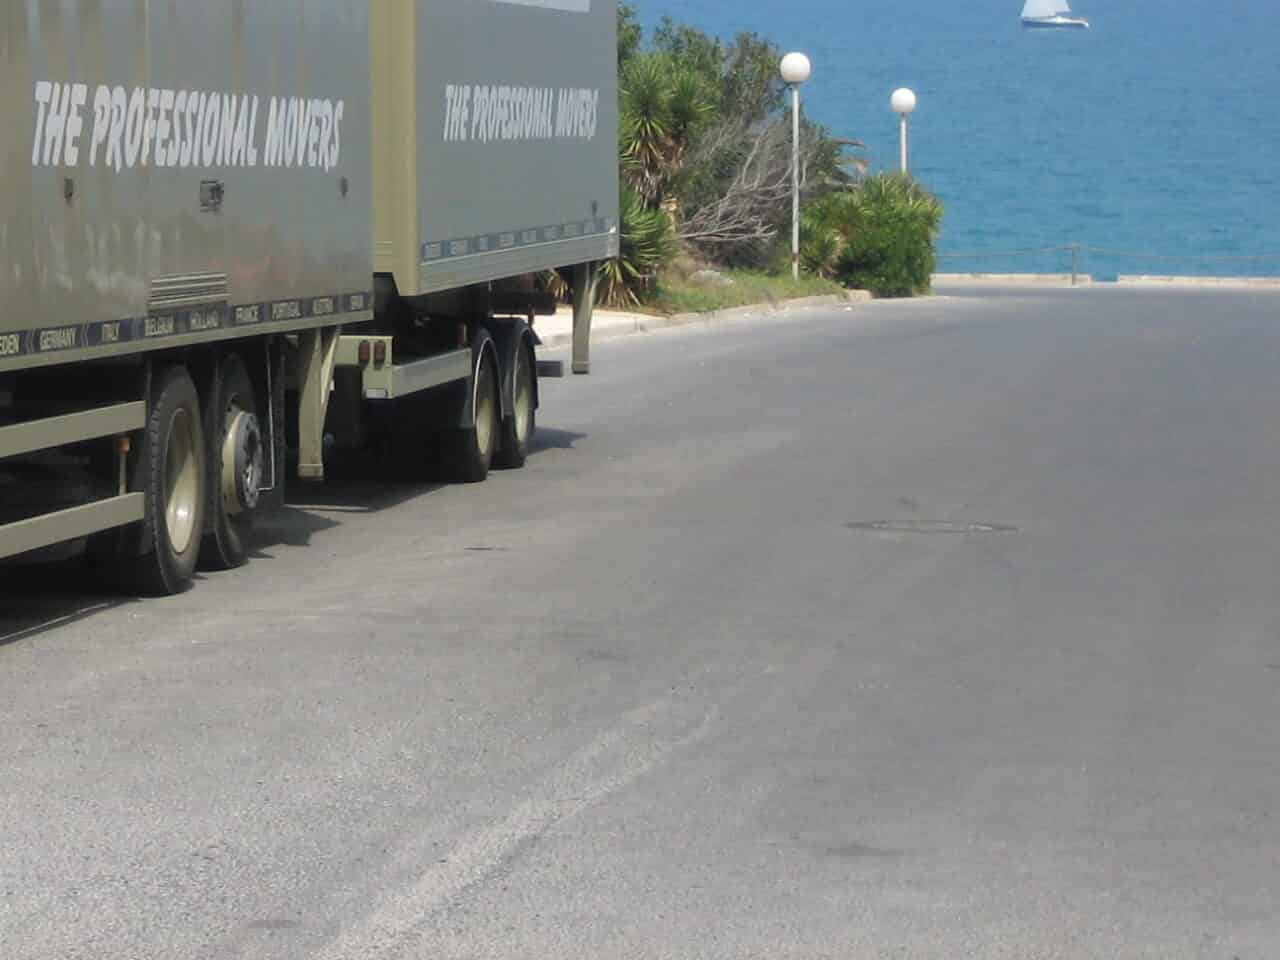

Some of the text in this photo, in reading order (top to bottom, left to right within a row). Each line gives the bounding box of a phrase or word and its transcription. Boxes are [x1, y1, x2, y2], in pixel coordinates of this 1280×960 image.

[31, 80, 343, 173] THE PROFESSIONAL MOVERS
[443, 84, 600, 144] THE PROFESSIONAL MOVERS
[40, 327, 78, 350] GERMANY
